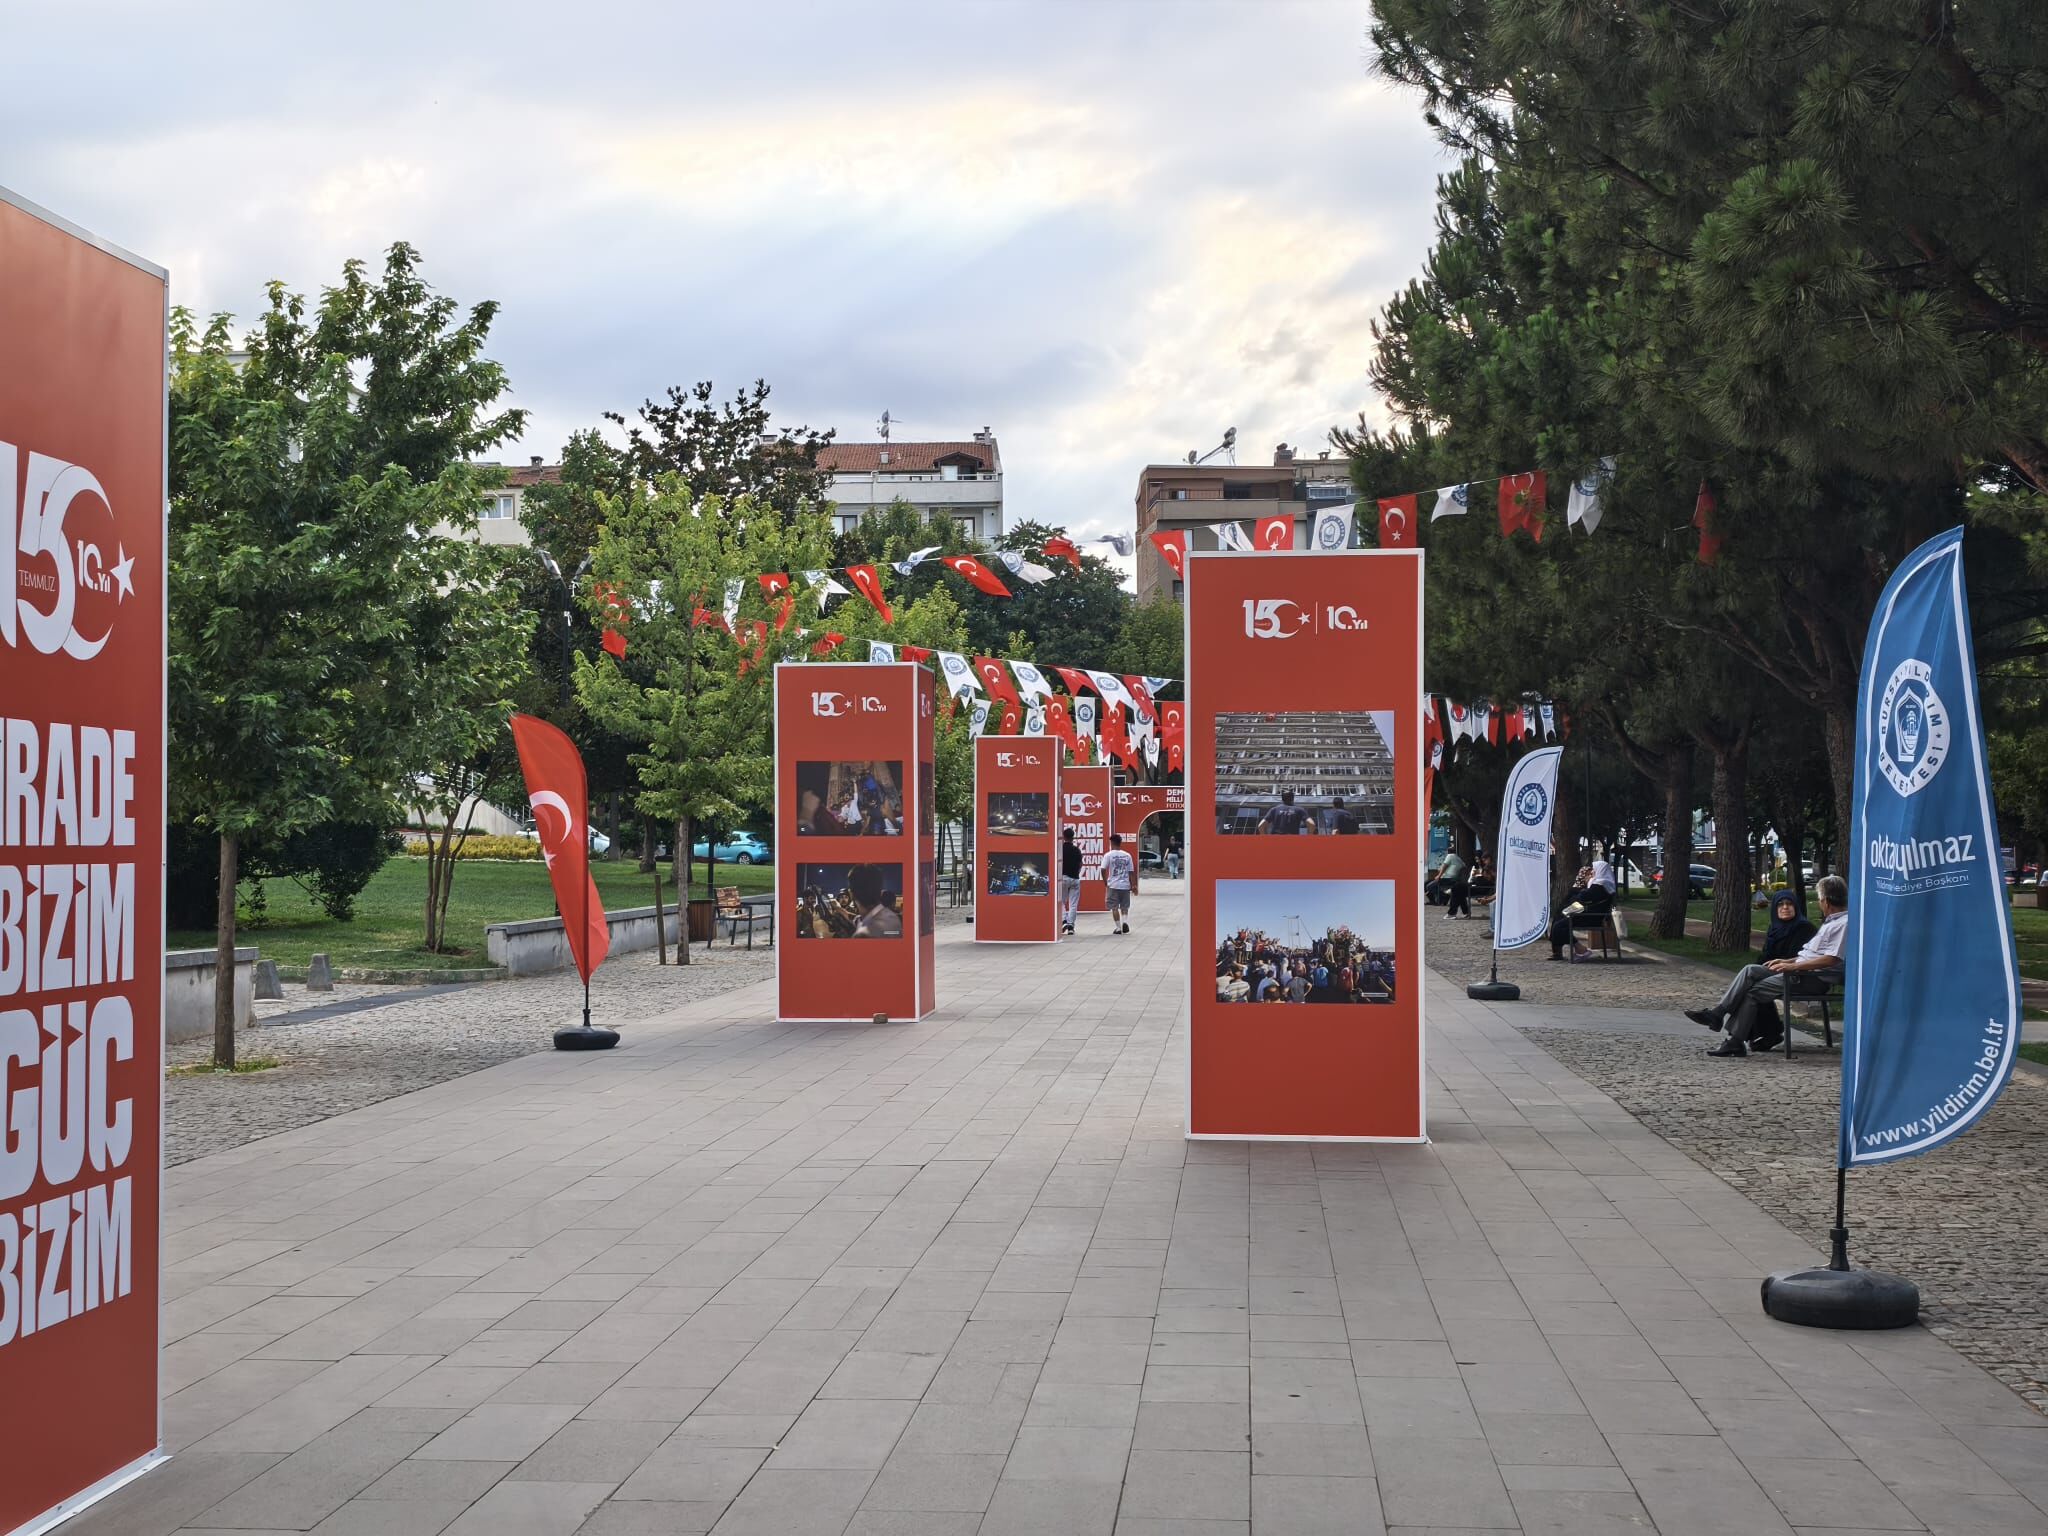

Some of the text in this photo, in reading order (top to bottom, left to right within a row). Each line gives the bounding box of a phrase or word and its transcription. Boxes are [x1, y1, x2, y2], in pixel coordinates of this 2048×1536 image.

[18, 569, 56, 592] TEMMUZ
[1243, 599, 1281, 639] 15
[811, 692, 836, 716] 15
[1064, 793, 1086, 816] 15
[1863, 1017, 2004, 1146] www.yildirim.bel.tr
